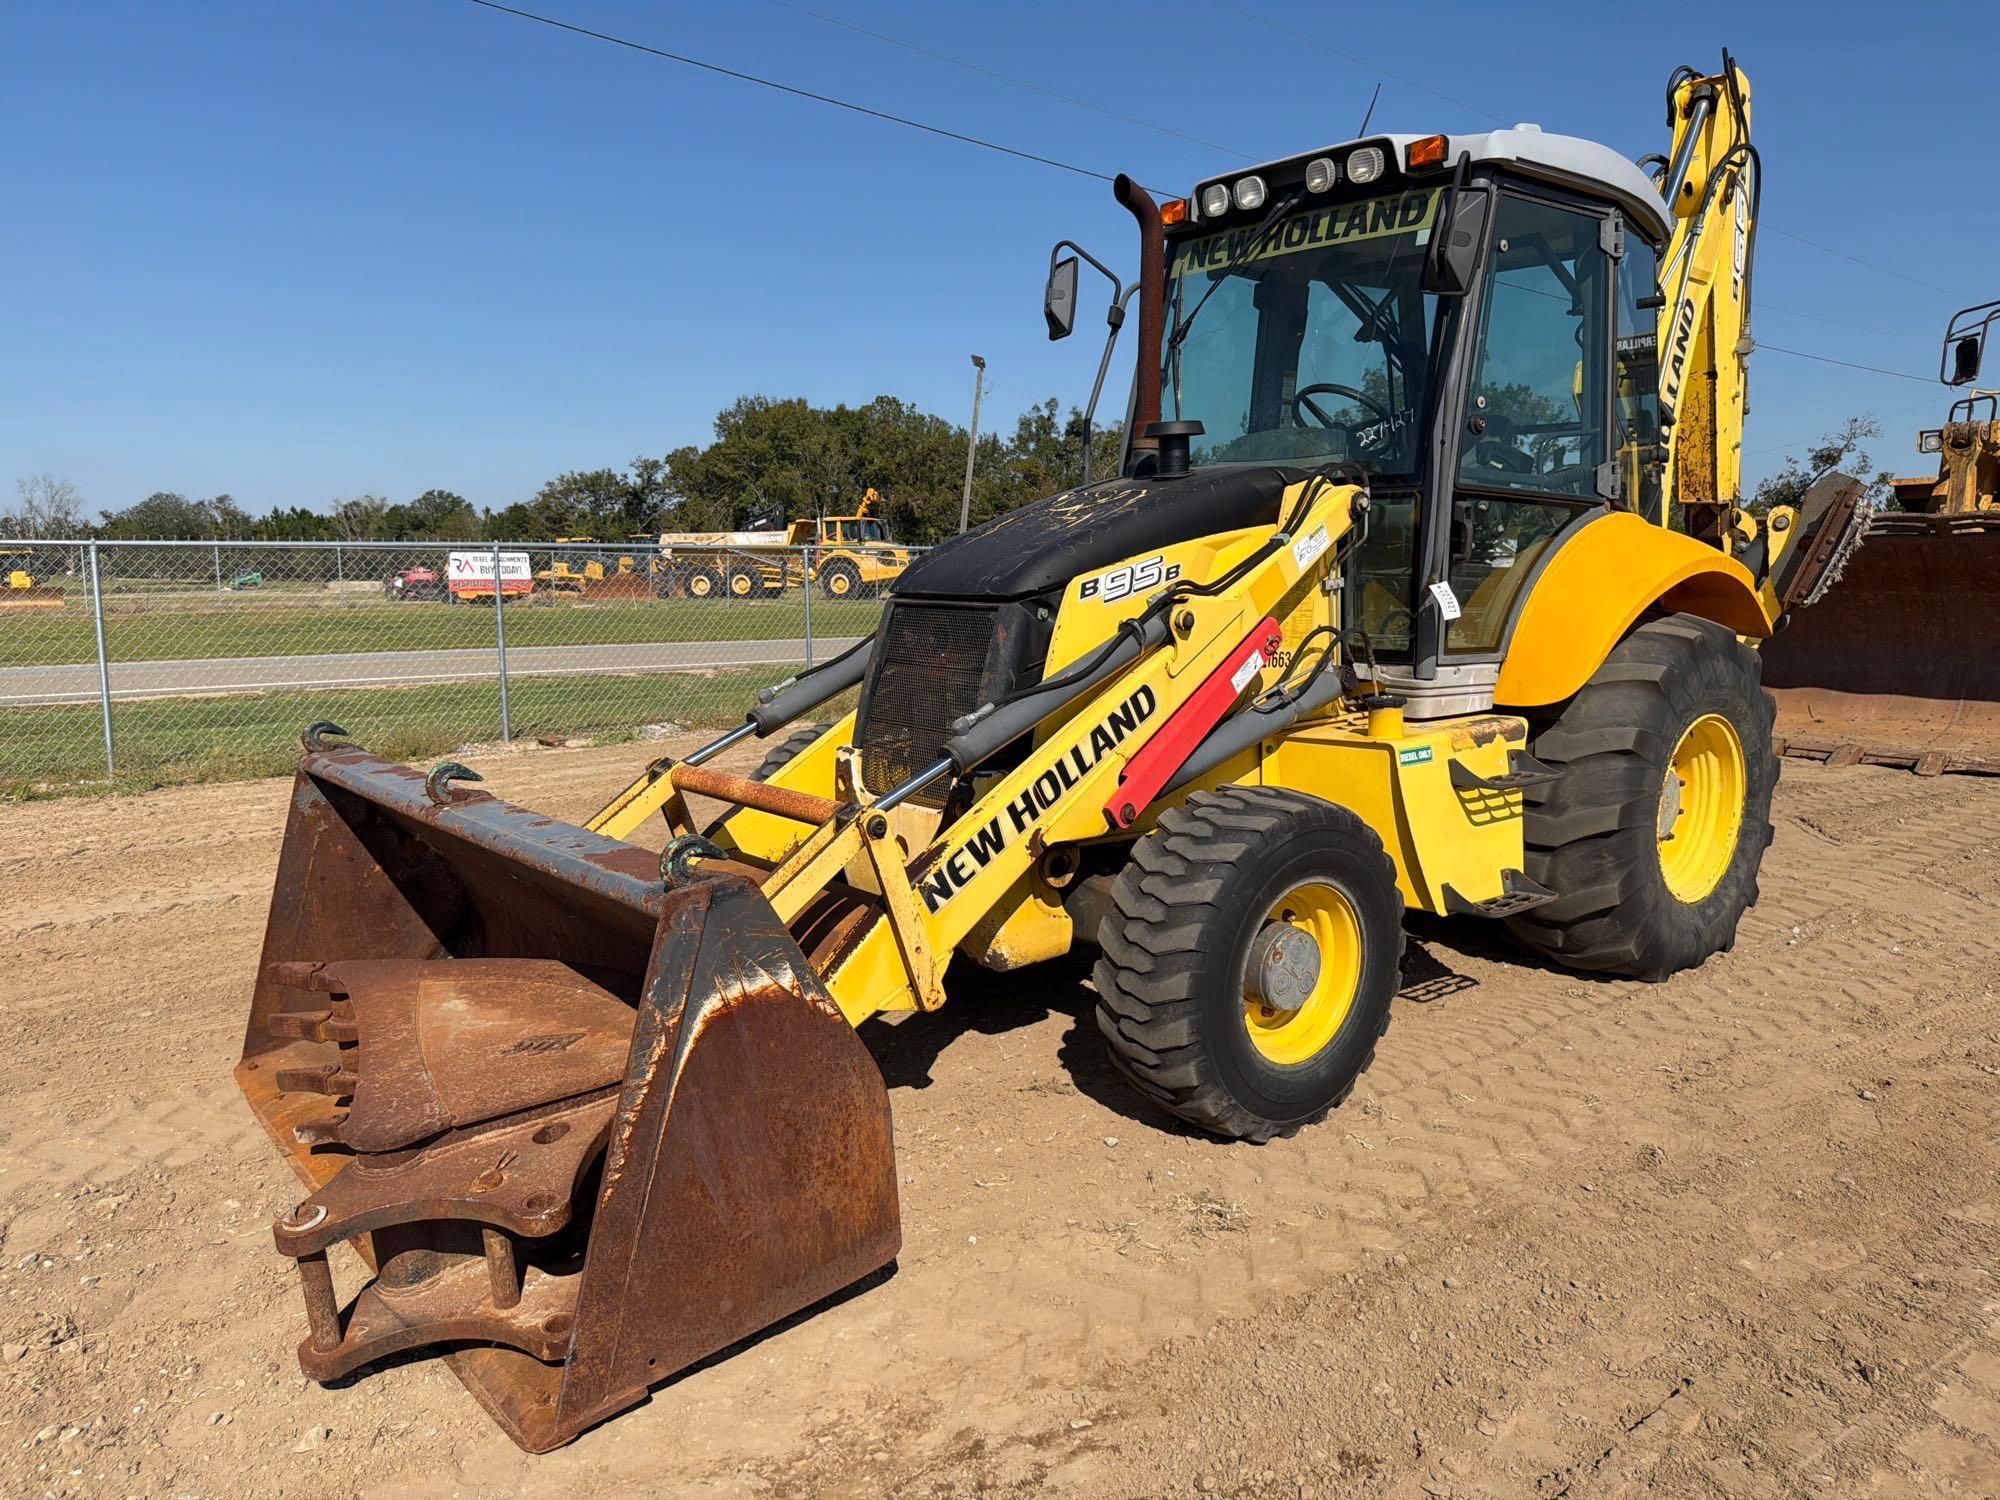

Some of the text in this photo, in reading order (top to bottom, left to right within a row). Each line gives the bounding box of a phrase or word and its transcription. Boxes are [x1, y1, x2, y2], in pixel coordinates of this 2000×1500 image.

[1187, 193, 1430, 270] NEW HOLLAND
[1356, 408, 1414, 447] 227427
[480, 565, 523, 575] BUY ODAY!
[1440, 589, 1457, 613] 227427
[1400, 749, 1431, 762] DIESEL ONLY
[917, 684, 1156, 914] NEW HOLLAND
